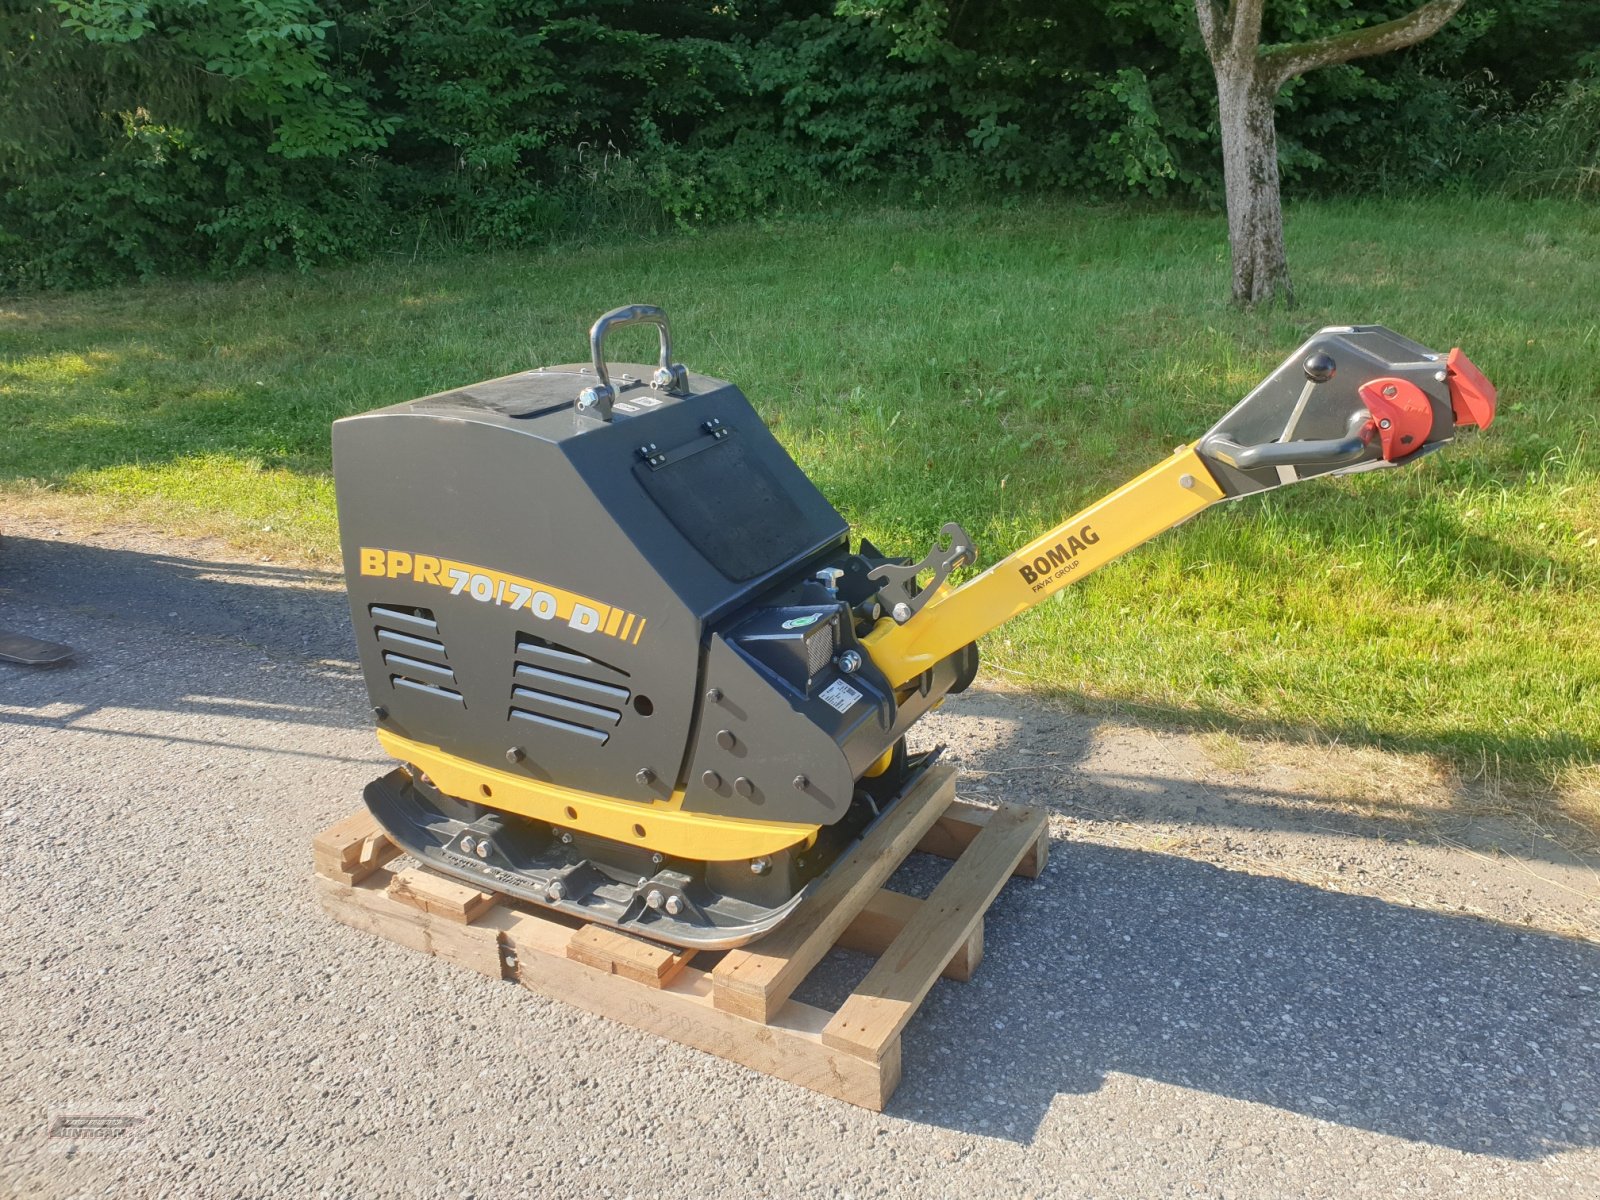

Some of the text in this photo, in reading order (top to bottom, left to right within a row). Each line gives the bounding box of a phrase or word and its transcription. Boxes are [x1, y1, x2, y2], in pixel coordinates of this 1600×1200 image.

[1019, 525, 1100, 585] BOMAG
[1032, 560, 1080, 593] FAYAT GROUP
[360, 547, 442, 586] BPR
[568, 603, 600, 634] D
